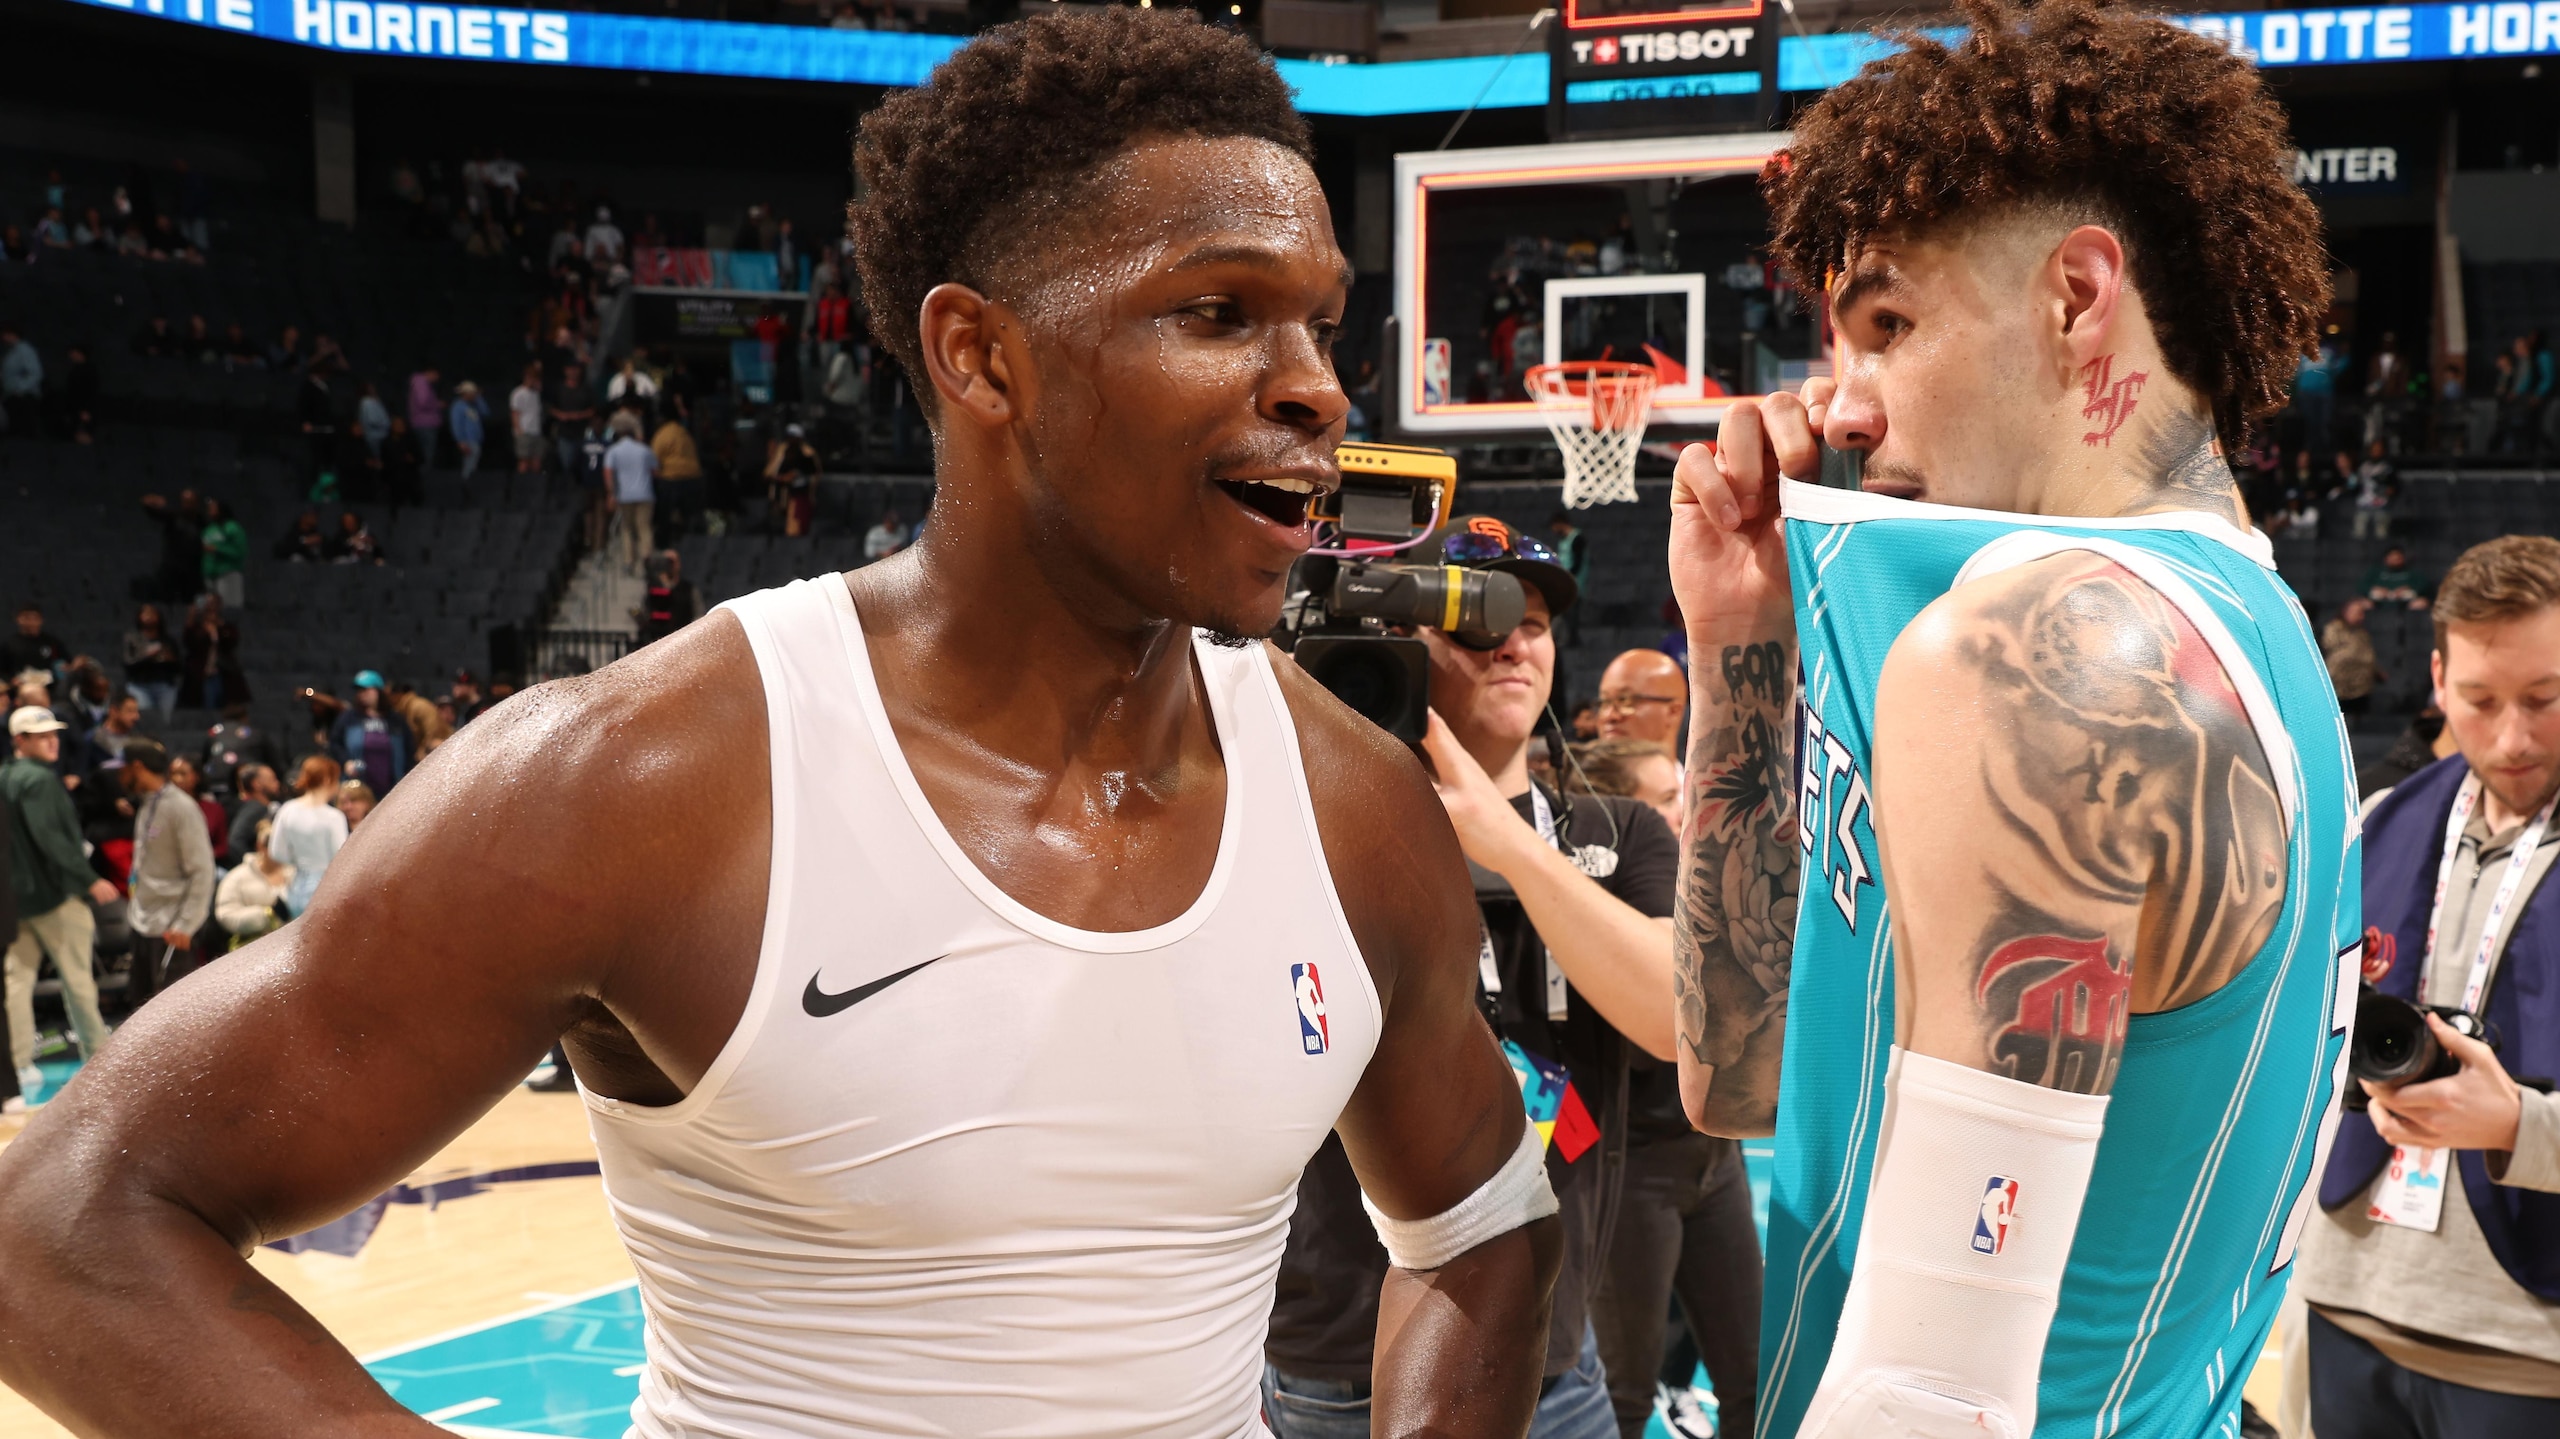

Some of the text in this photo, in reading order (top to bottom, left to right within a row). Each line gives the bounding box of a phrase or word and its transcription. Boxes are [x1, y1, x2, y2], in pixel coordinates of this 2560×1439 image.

[293, 0, 569, 62] HORNETS
[1620, 27, 1754, 64] TISSOT
[1722, 640, 1785, 718] GOD
[1306, 1035, 1321, 1051] NBA
[1973, 1234, 1993, 1251] NBA
